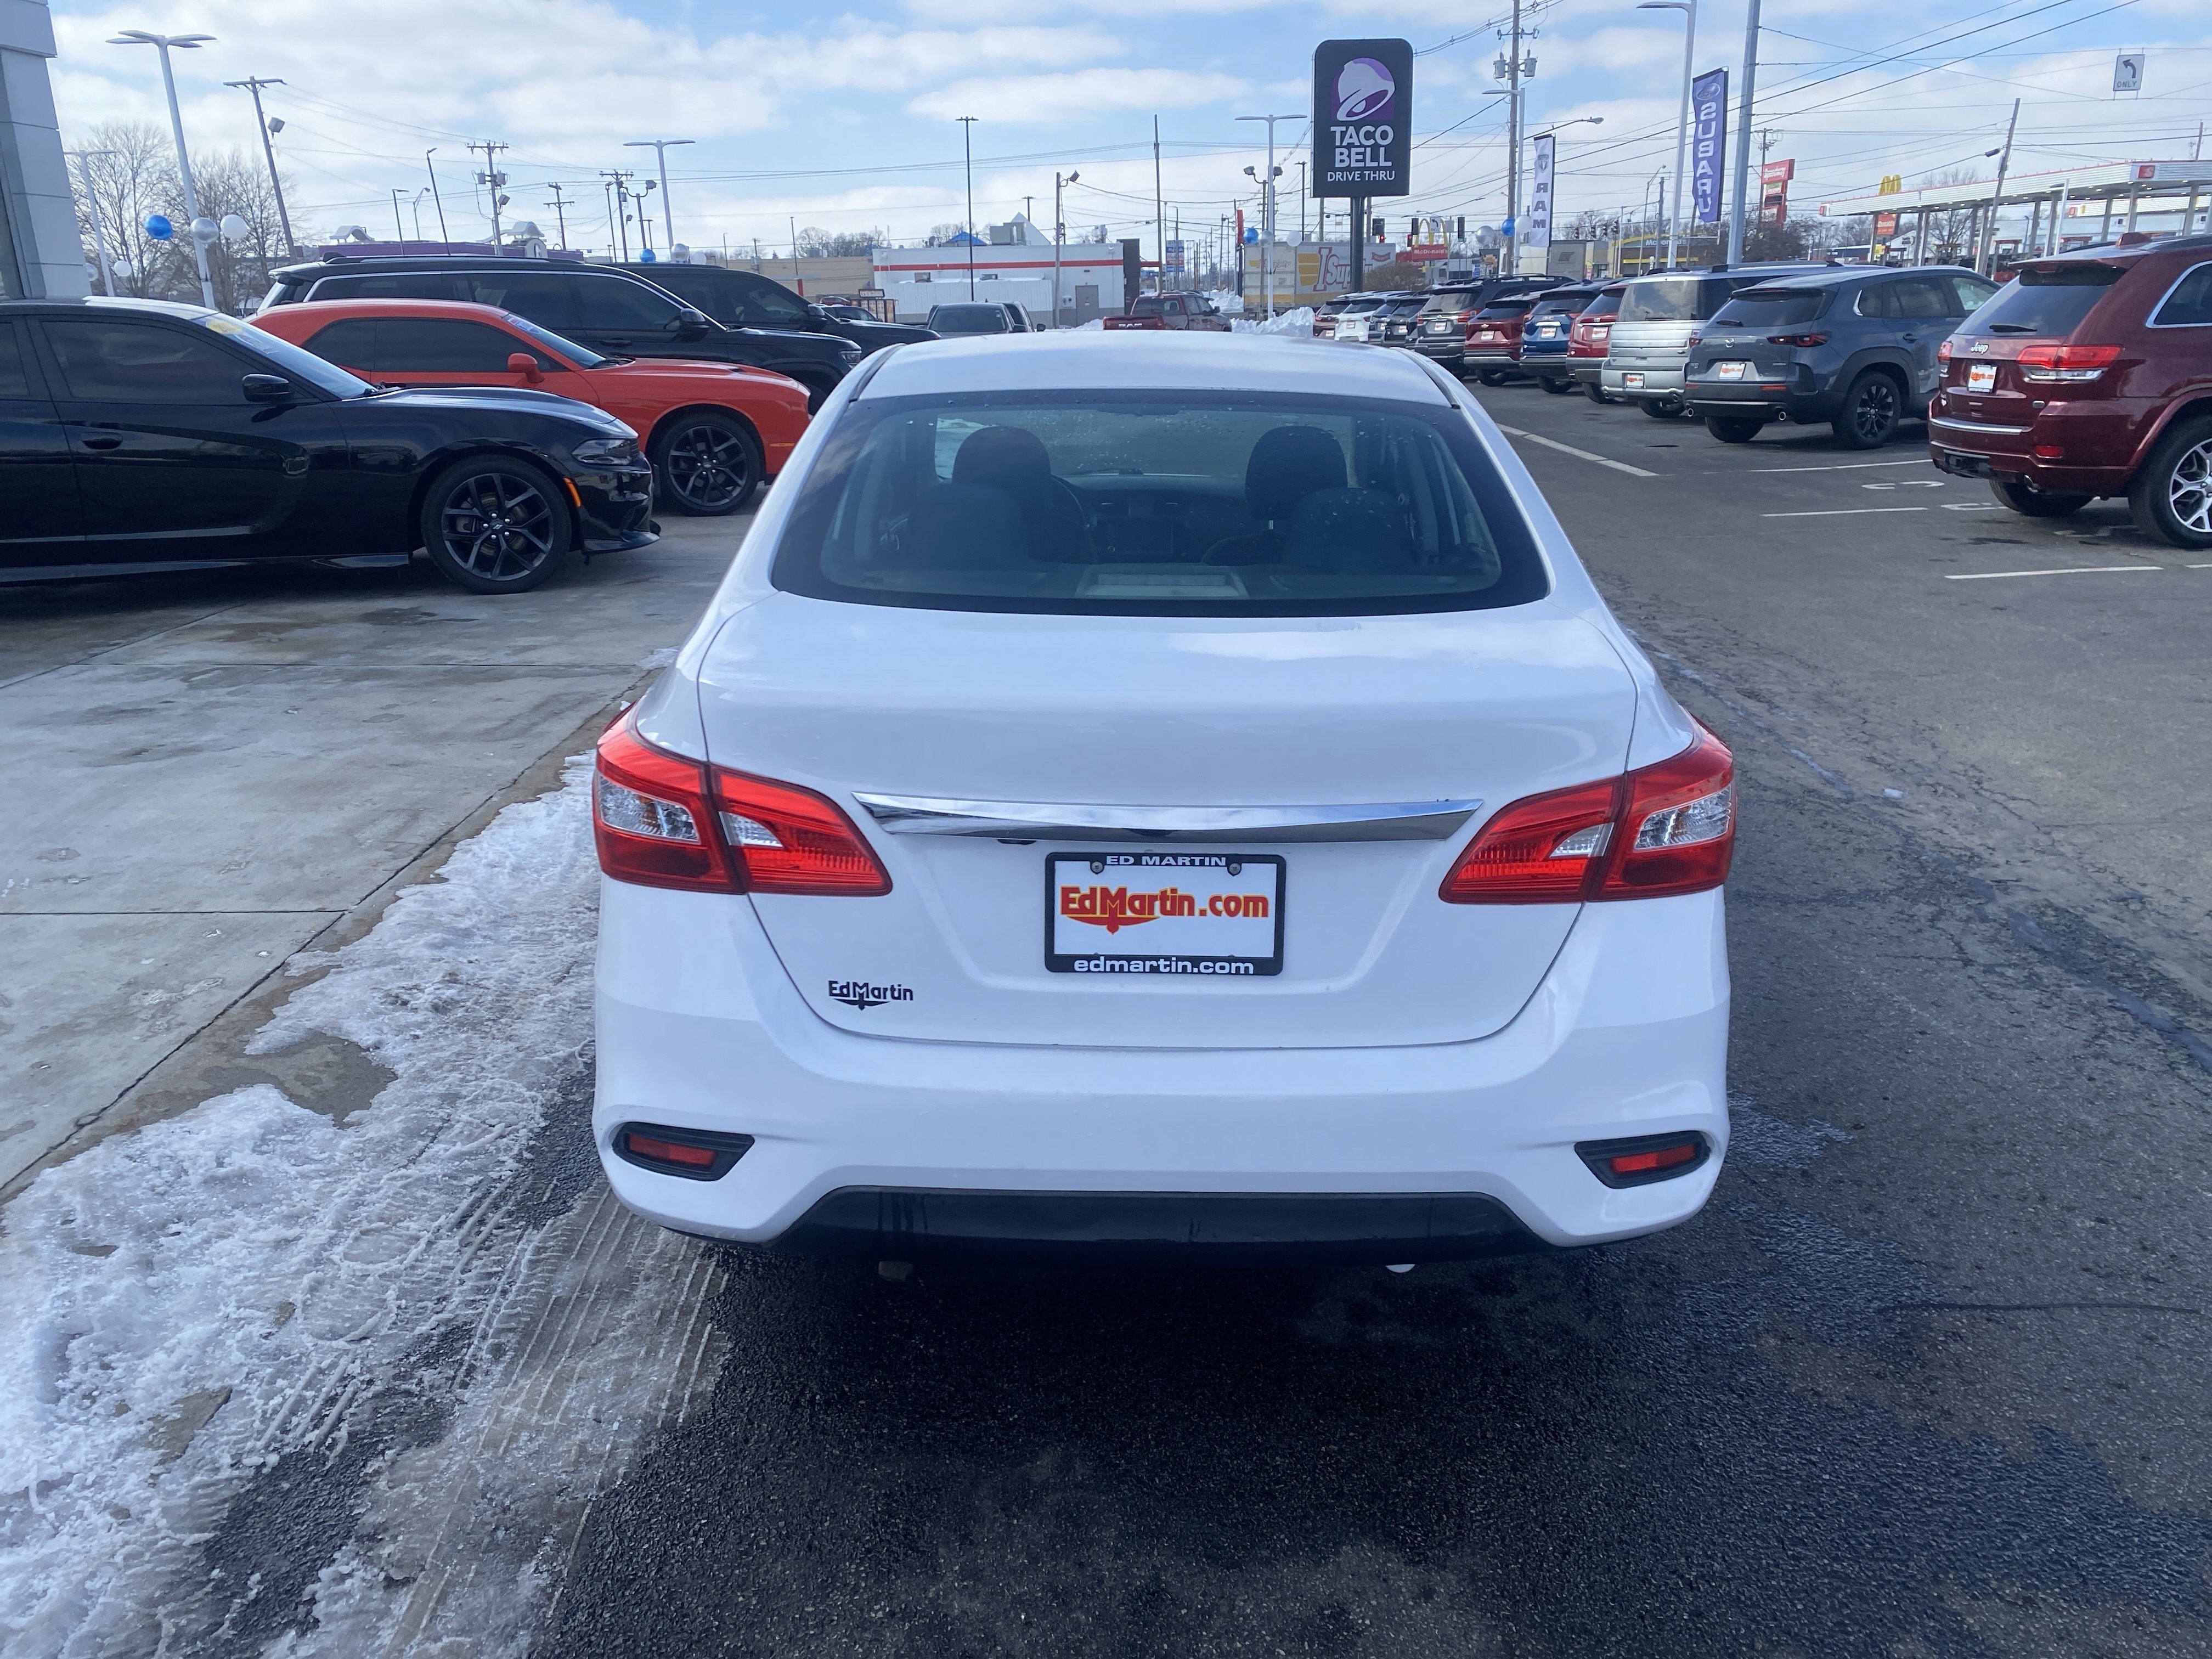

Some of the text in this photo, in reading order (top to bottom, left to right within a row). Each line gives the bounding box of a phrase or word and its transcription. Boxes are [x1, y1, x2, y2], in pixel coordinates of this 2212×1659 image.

[2116, 80, 2137, 88] ONLY
[1330, 125, 1394, 146] TACO
[1335, 146, 1392, 167] BELL
[1327, 170, 1395, 182] DRIVE THRU
[1971, 341, 1989, 354] Jeep
[1106, 856, 1227, 866] ED MARTIN
[1060, 885, 1269, 918] EdMartin.com
[1074, 956, 1254, 975] edmartin.com
[828, 980, 913, 1001] EdMartin
